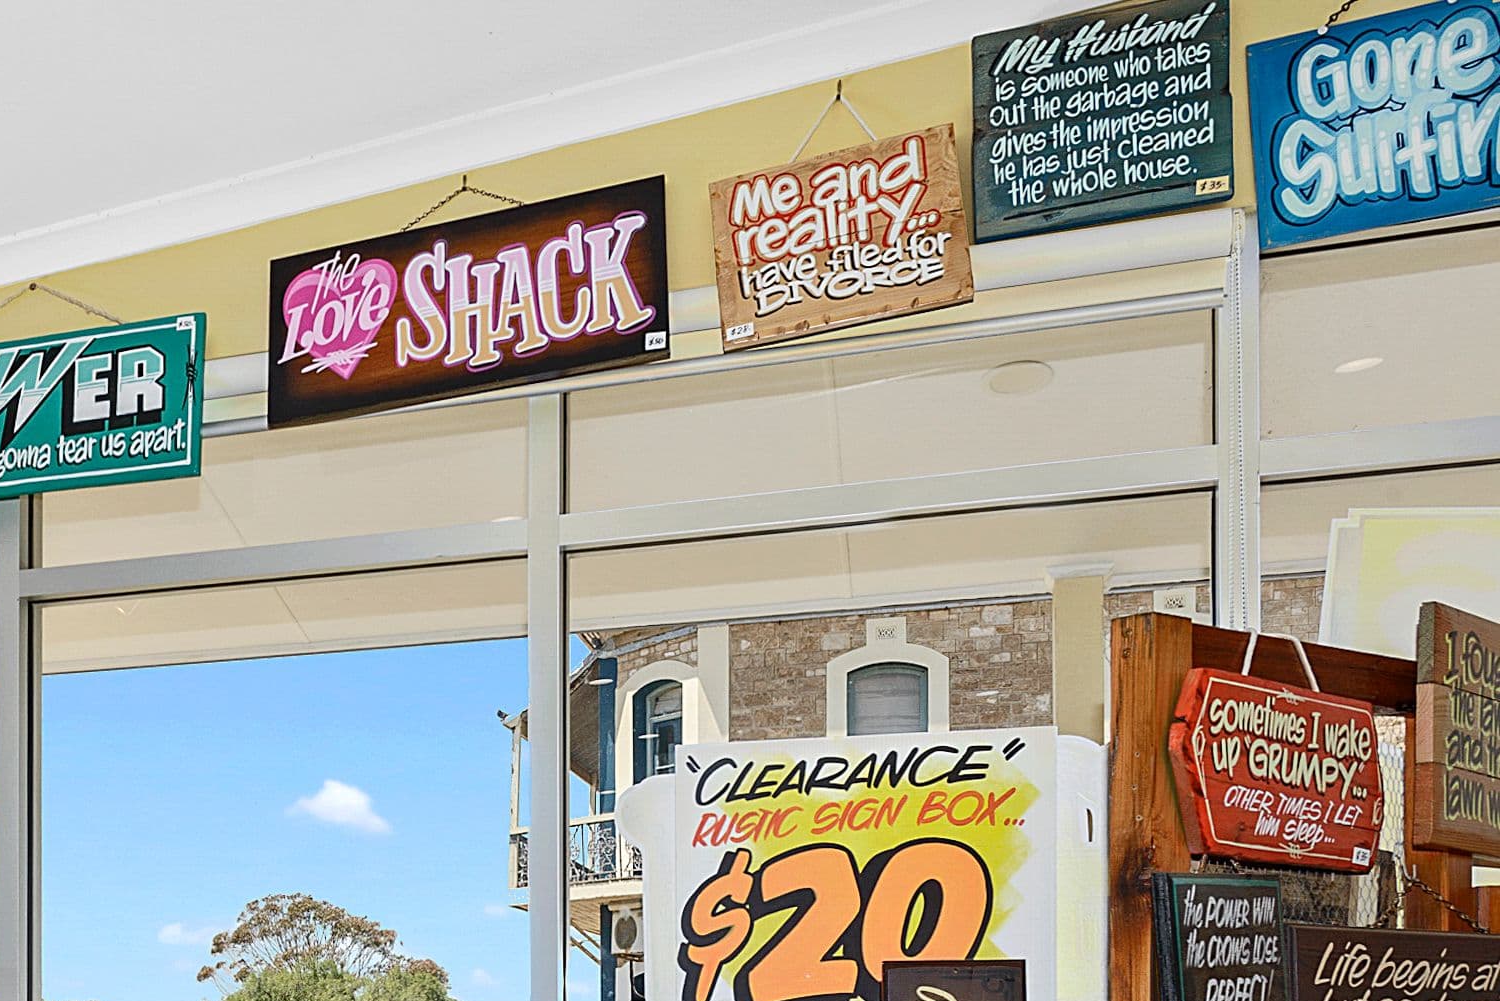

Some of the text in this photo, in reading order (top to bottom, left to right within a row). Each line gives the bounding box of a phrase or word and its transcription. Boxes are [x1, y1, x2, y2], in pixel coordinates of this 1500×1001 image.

[995, 2, 1218, 75] My Husband
[1298, 15, 1499, 120] Gone
[734, 136, 922, 225] Me and
[1008, 155, 1197, 206] the whole house.
[311, 253, 360, 301] The
[396, 212, 656, 370] SHACK
[755, 260, 945, 315] DIVORCE
[57, 436, 94, 464] tear
[101, 435, 125, 456] us
[131, 421, 186, 454] apart.
[1209, 698, 1371, 762] sometimes I wake
[1211, 739, 1239, 781] up
[692, 806, 802, 848] RUSTIC
[811, 795, 907, 836] SIGN
[1184, 890, 1203, 929] the
[1204, 893, 1249, 928] POWER
[1314, 941, 1469, 995] Life begins
